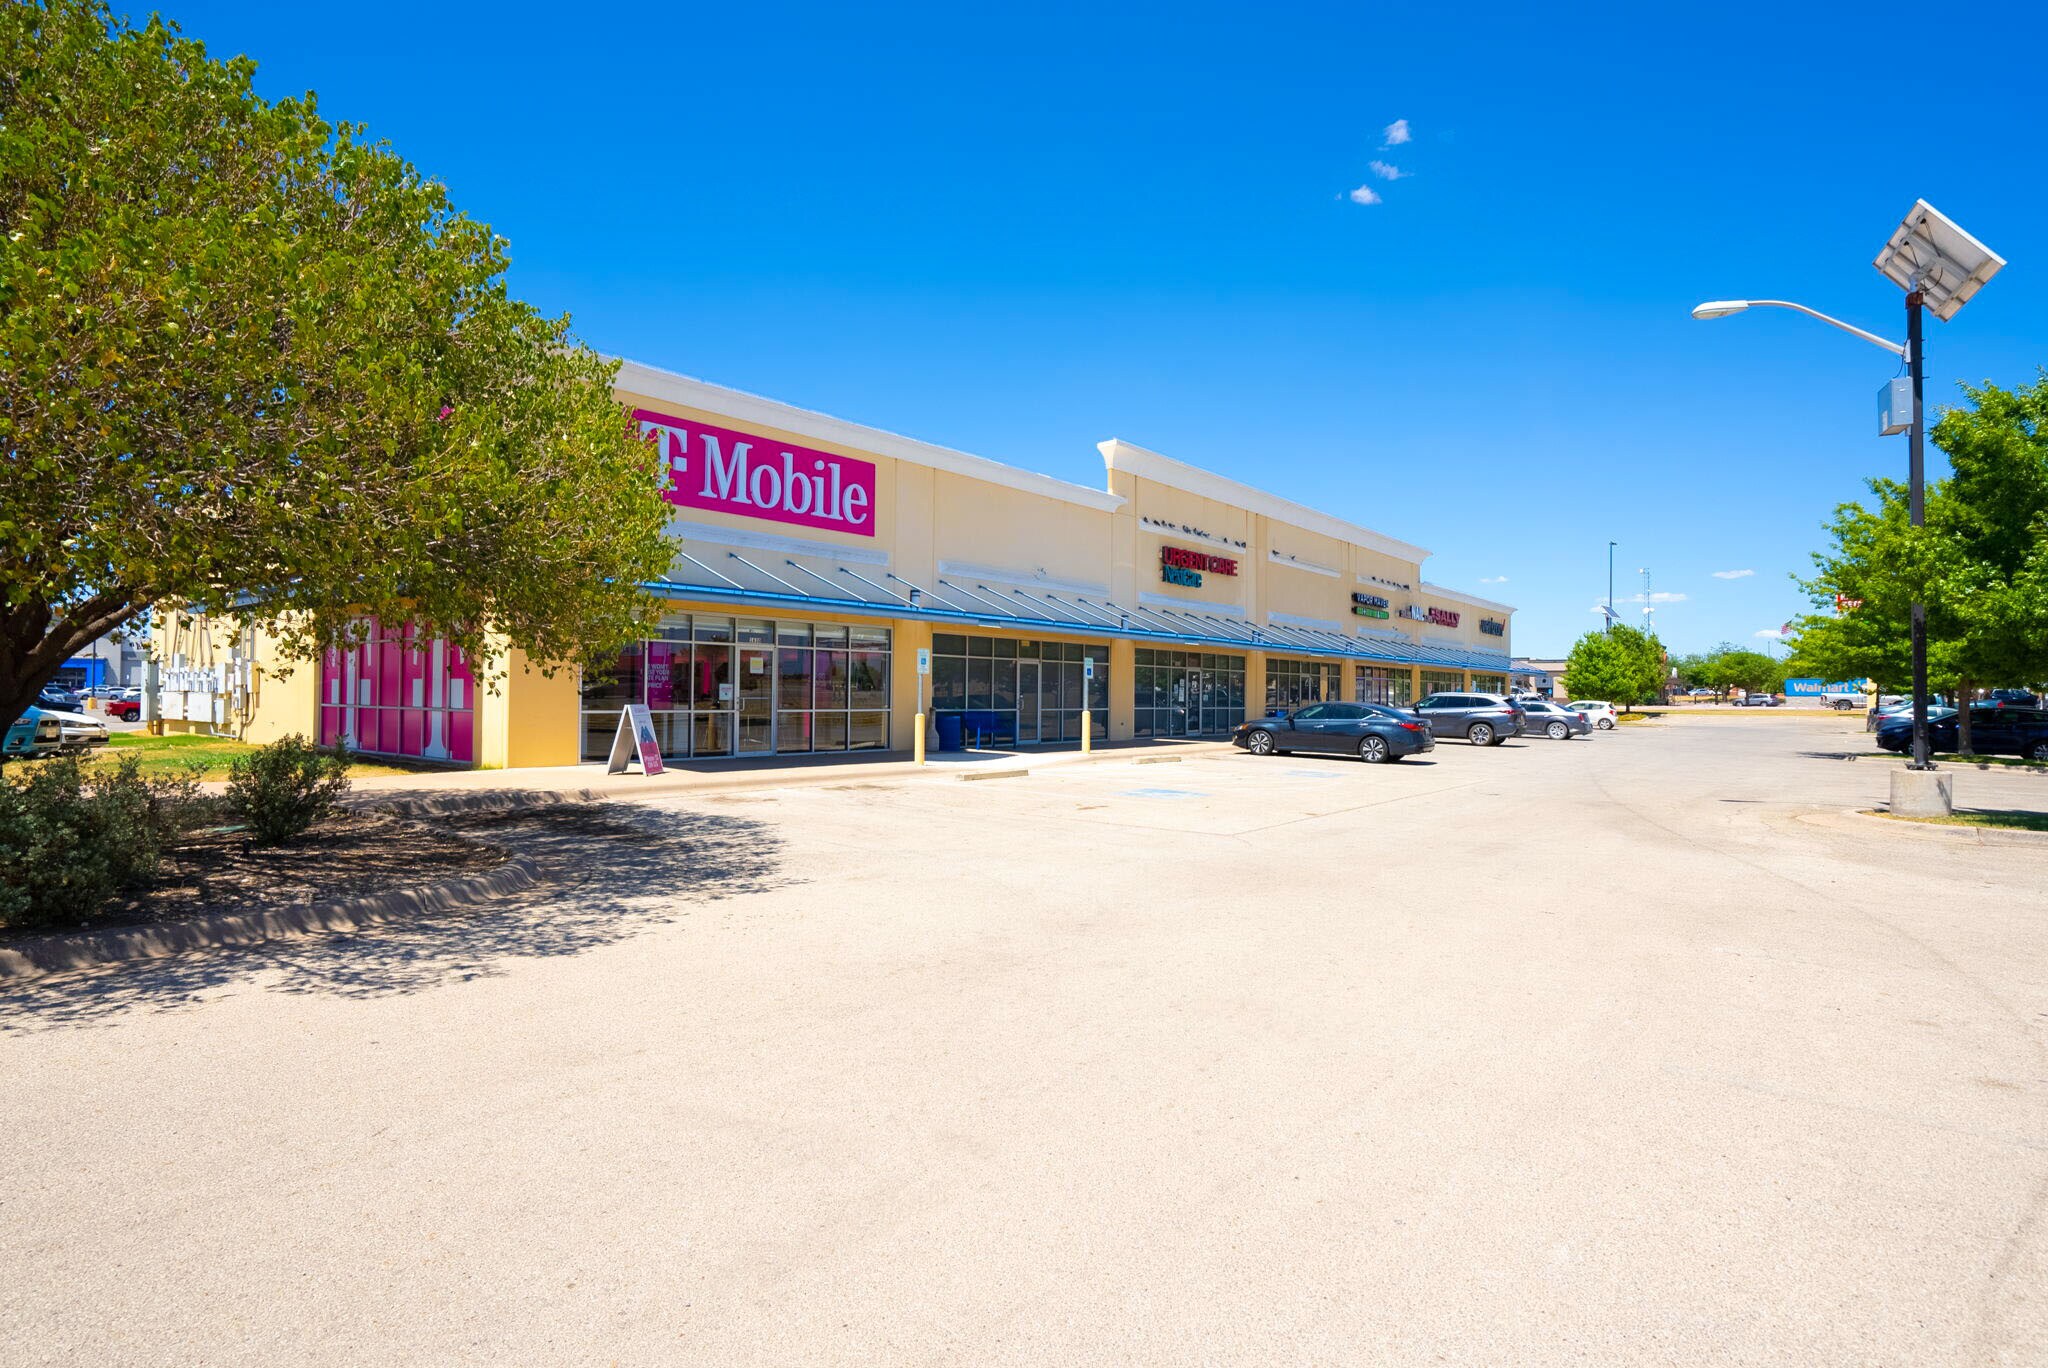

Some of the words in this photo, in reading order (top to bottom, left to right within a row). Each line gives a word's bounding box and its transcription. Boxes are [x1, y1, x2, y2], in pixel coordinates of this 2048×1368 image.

[698, 433, 868, 525] Mobile
[1162, 546, 1209, 571] URGENT
[1208, 556, 1238, 577] CARE
[1793, 682, 1849, 693] Walmart
